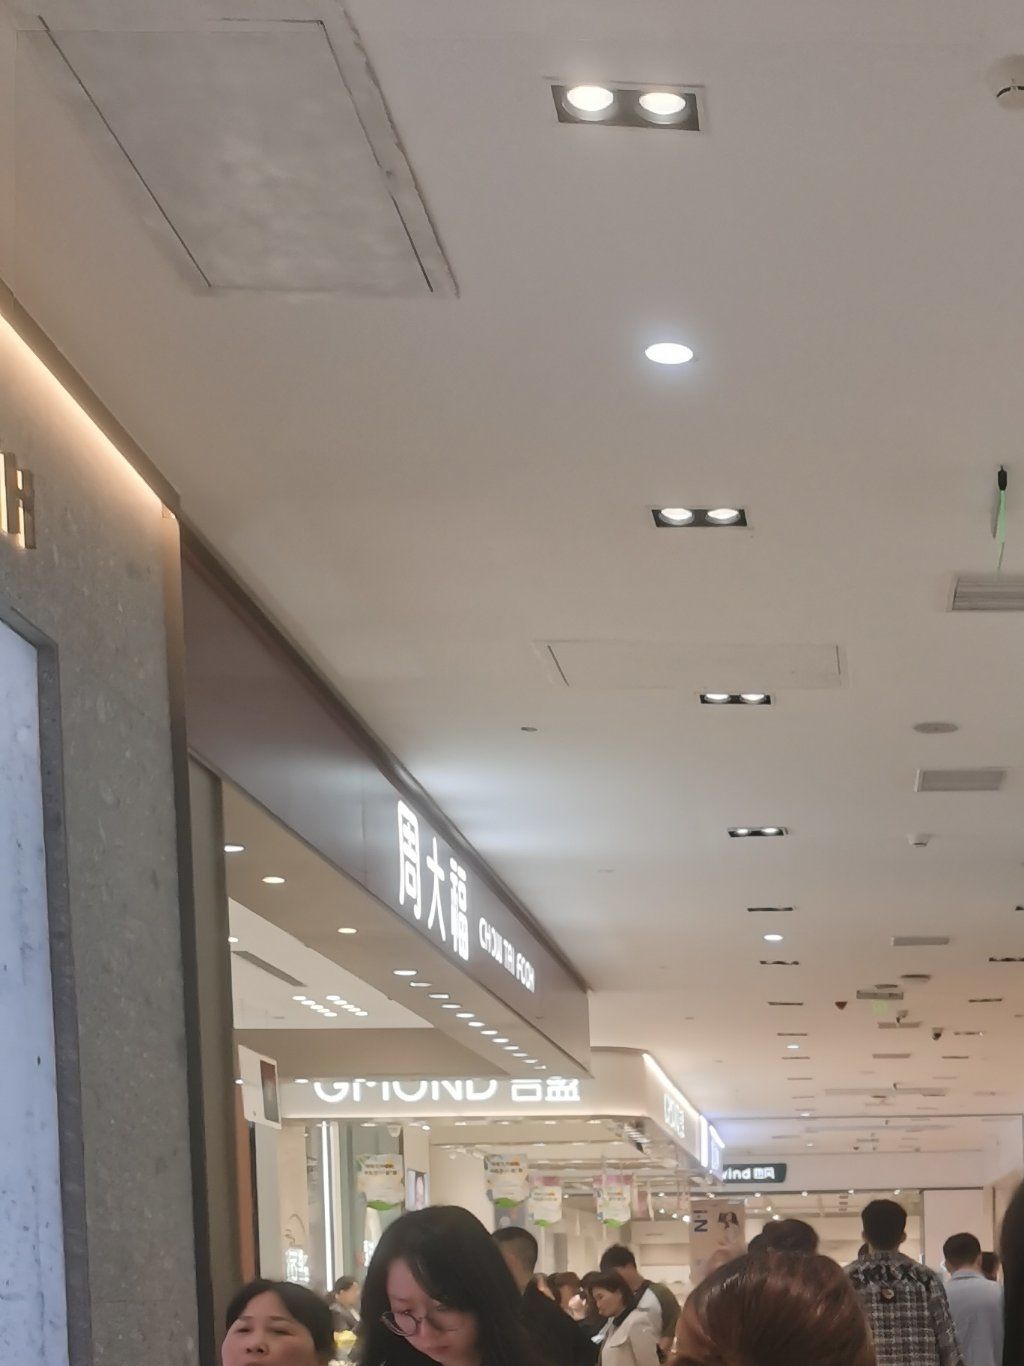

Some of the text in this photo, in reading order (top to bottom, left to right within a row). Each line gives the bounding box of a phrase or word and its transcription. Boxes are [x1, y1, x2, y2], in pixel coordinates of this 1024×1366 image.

[397, 800, 470, 961] 周大福
[478, 916, 503, 965] CHOW
[503, 940, 515, 977] TAI
